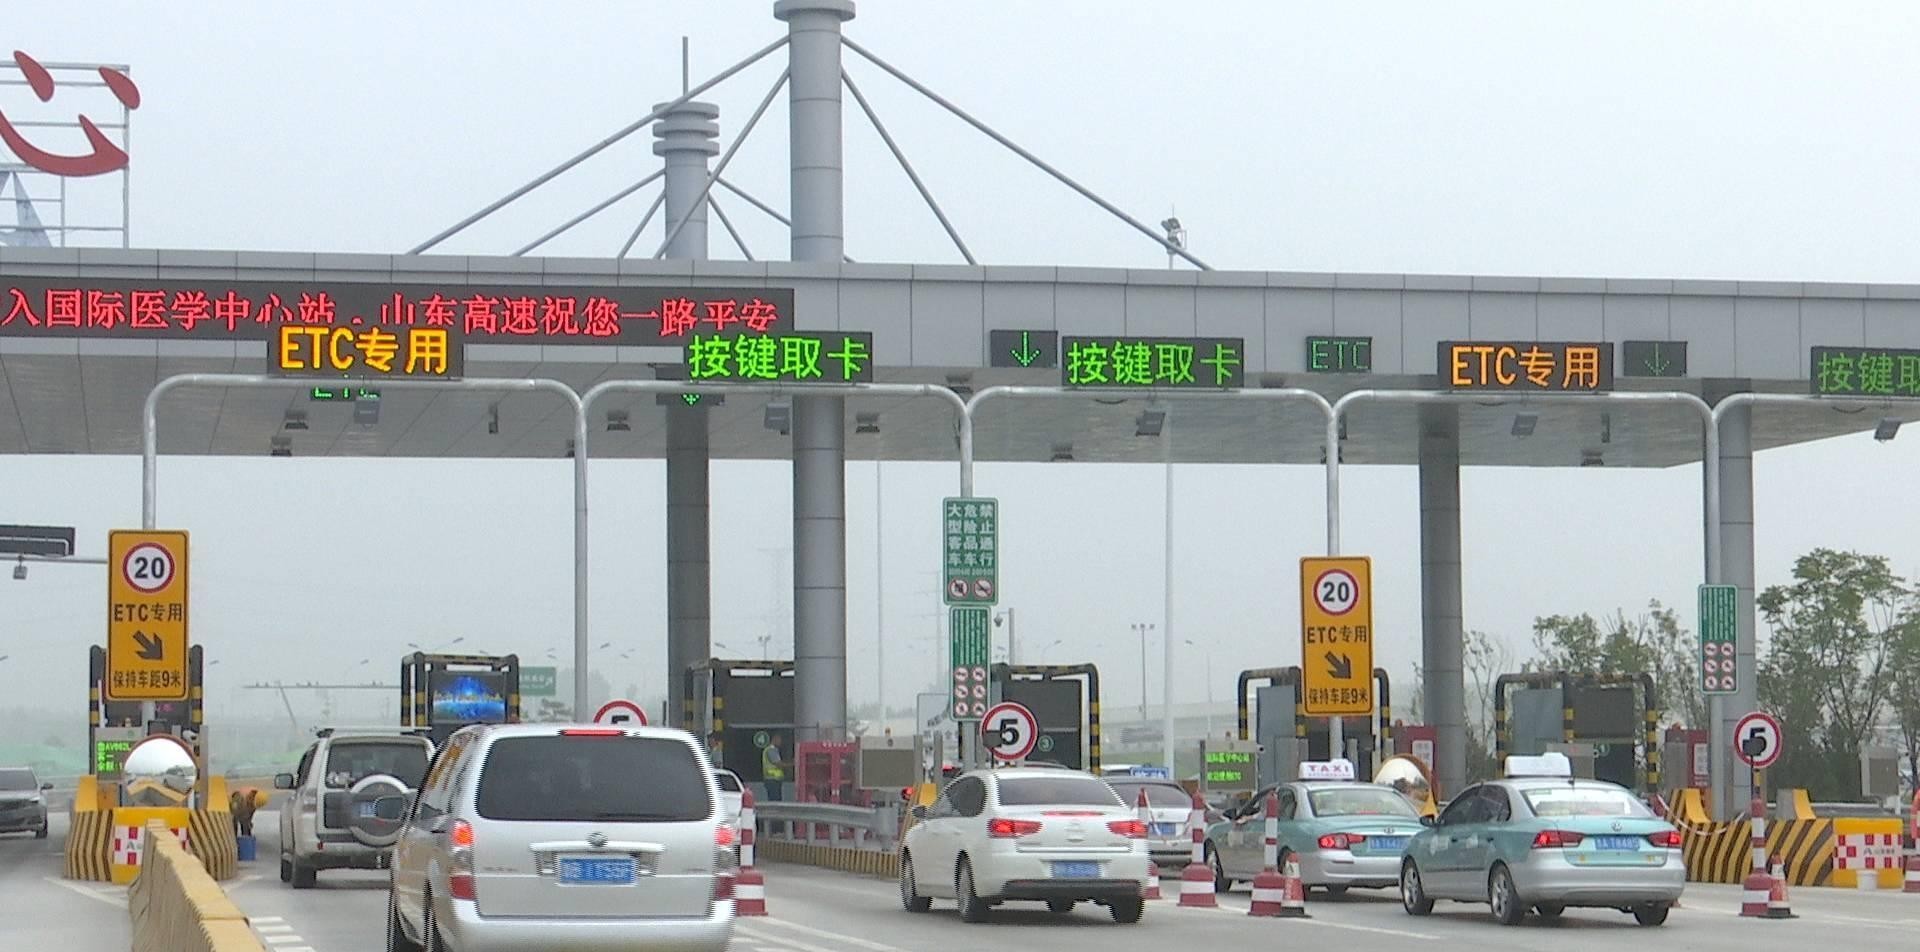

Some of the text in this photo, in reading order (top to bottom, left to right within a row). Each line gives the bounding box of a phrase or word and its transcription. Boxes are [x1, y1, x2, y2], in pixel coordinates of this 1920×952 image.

[280, 325, 448, 375] ETC专用
[688, 334, 869, 380] 按键取卡
[1067, 340, 1240, 385] 按键取卡
[1311, 340, 1369, 370] ETC
[1451, 345, 1600, 388] ETC专用
[134, 557, 165, 579] 20
[1322, 581, 1350, 602] 20
[114, 602, 182, 622] ETC专用
[1307, 624, 1367, 644] ETC专用
[113, 669, 181, 689] 保持车距9米
[1308, 686, 1368, 705] 保持车距9米
[1000, 718, 1019, 746] 5
[1749, 727, 1767, 757] 5
[1308, 764, 1350, 773] TAXI
